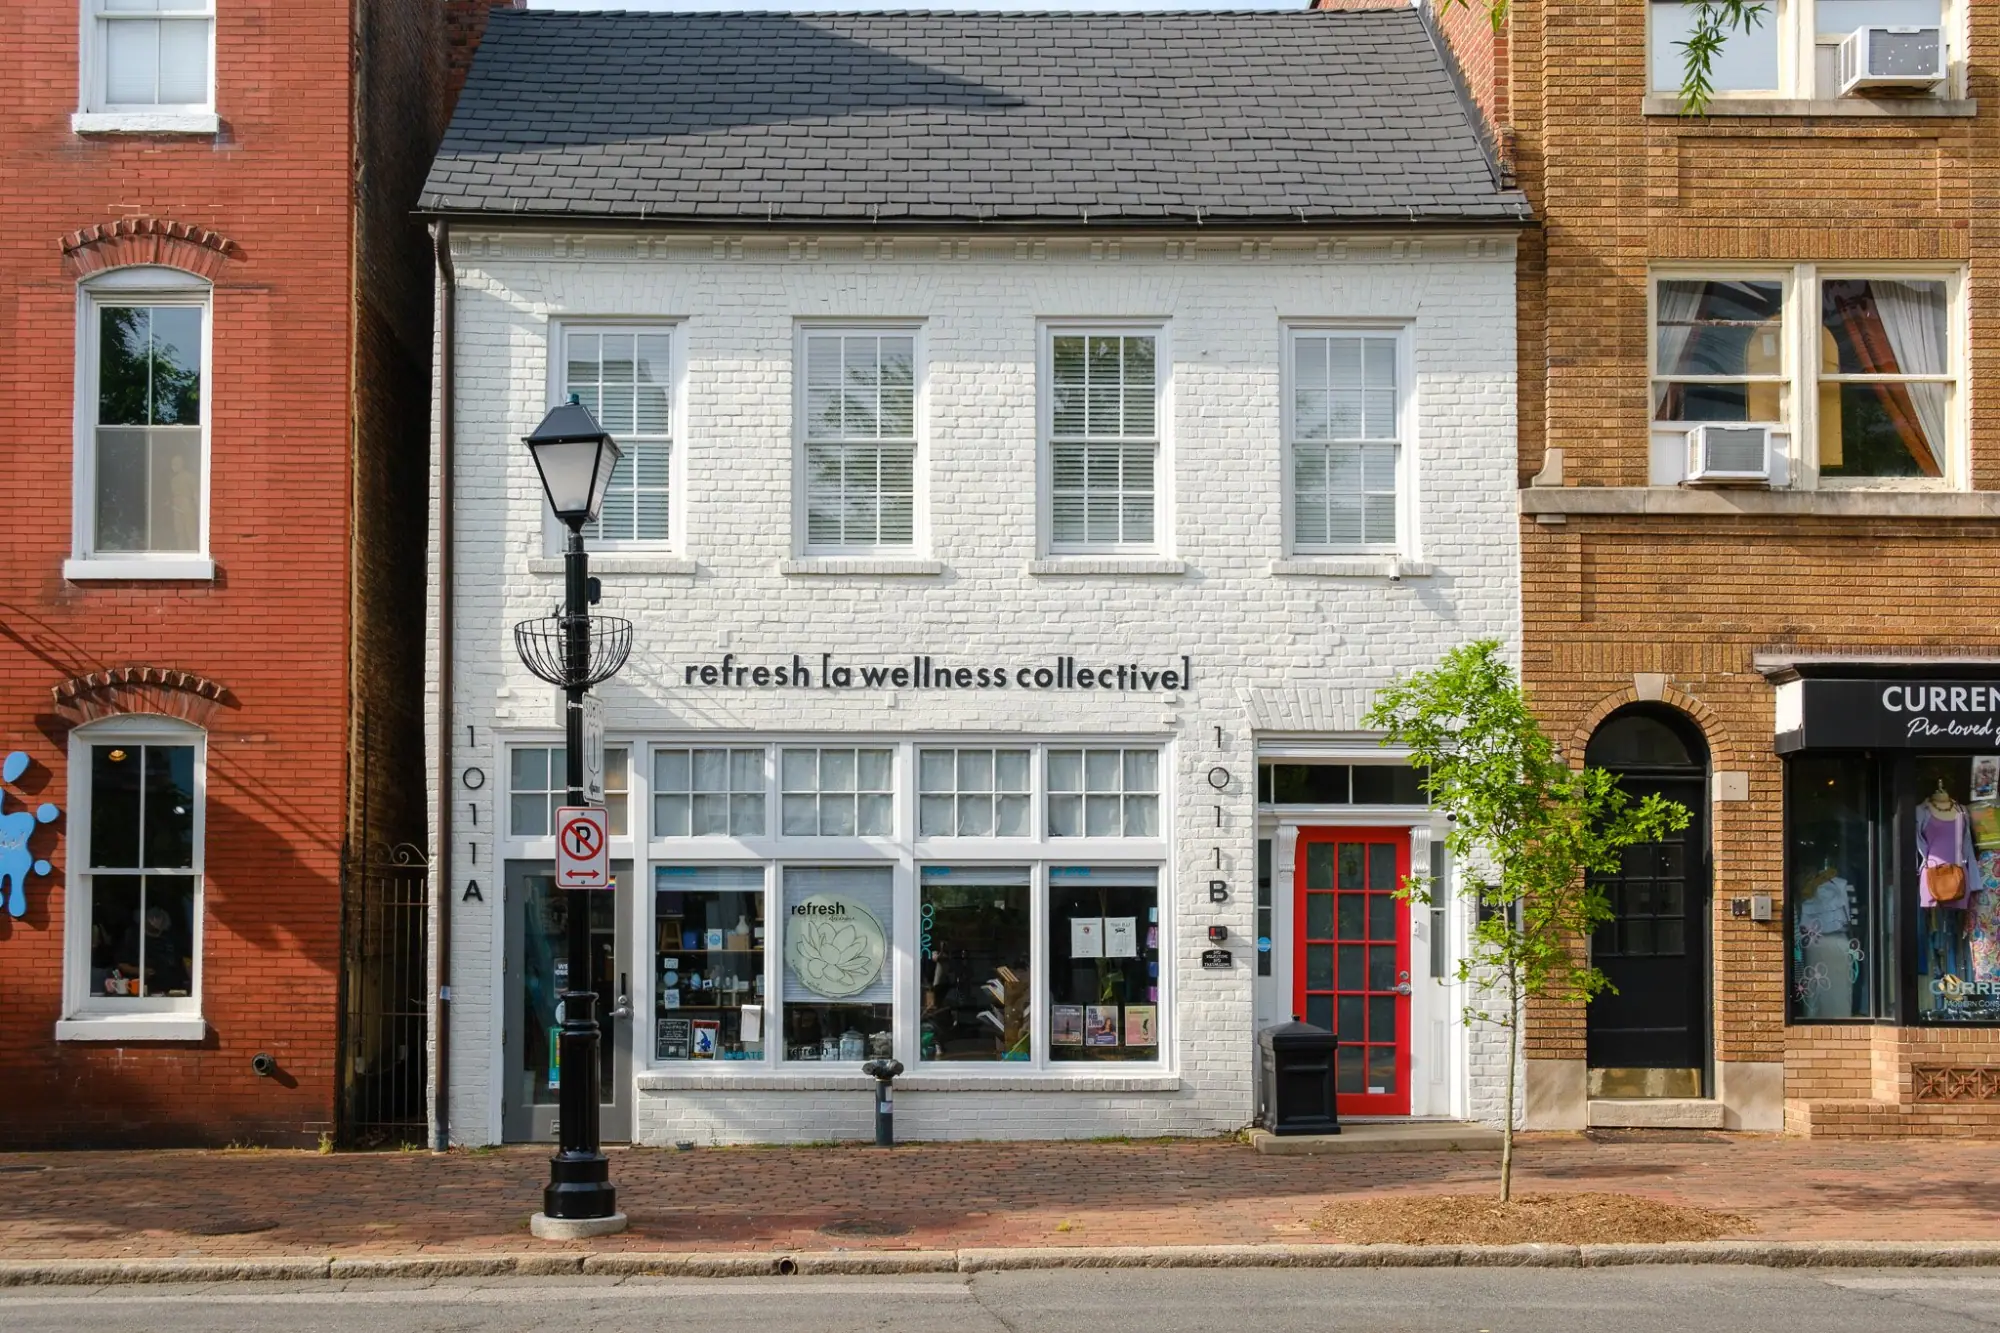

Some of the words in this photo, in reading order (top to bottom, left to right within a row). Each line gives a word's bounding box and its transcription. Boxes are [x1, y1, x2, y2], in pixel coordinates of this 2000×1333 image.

[685, 653, 810, 687] refresh
[860, 656, 1008, 689] wellness
[1016, 656, 1190, 690] collective]
[1907, 716, 1993, 738] Pre-loved
[791, 901, 845, 915] refresh
